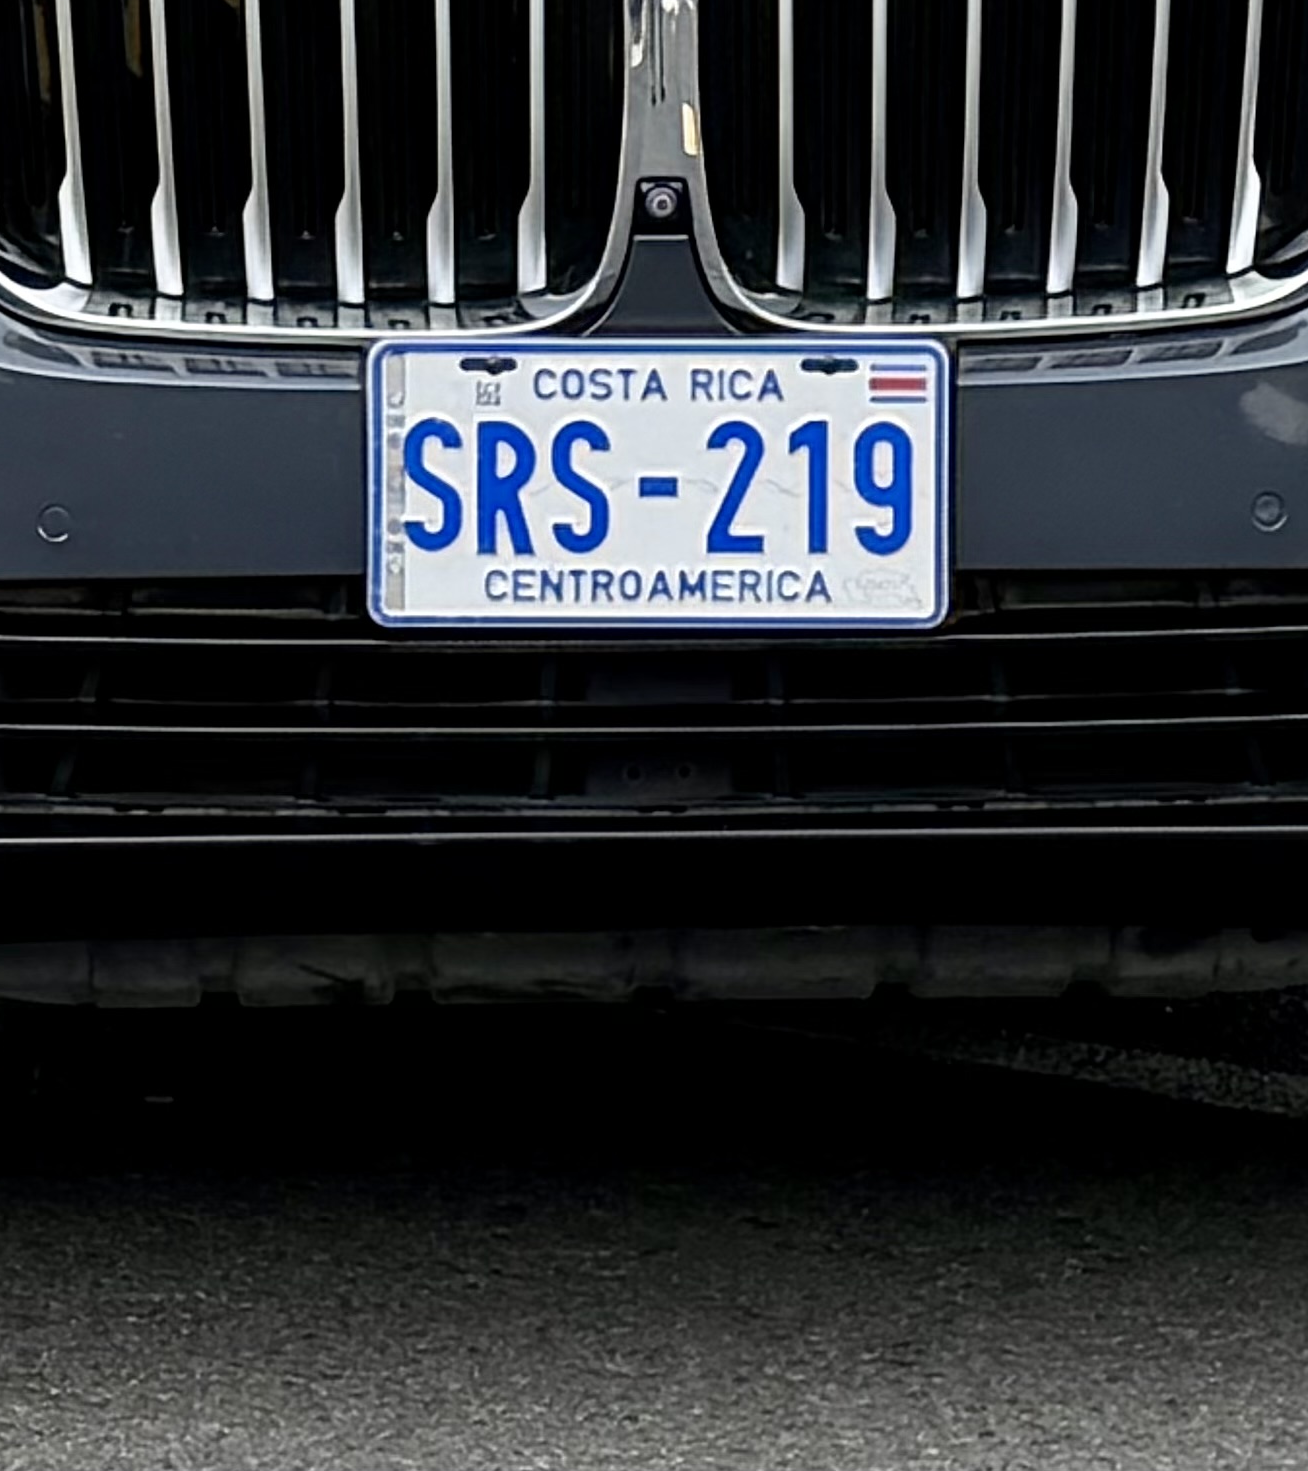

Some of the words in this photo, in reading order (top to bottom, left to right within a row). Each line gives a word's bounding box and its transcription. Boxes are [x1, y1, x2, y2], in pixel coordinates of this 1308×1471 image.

[532, 368, 668, 403] COSTA
[690, 368, 785, 403] RICA
[402, 419, 914, 556] SRS-219
[484, 568, 833, 604] CENTROAMERICA
